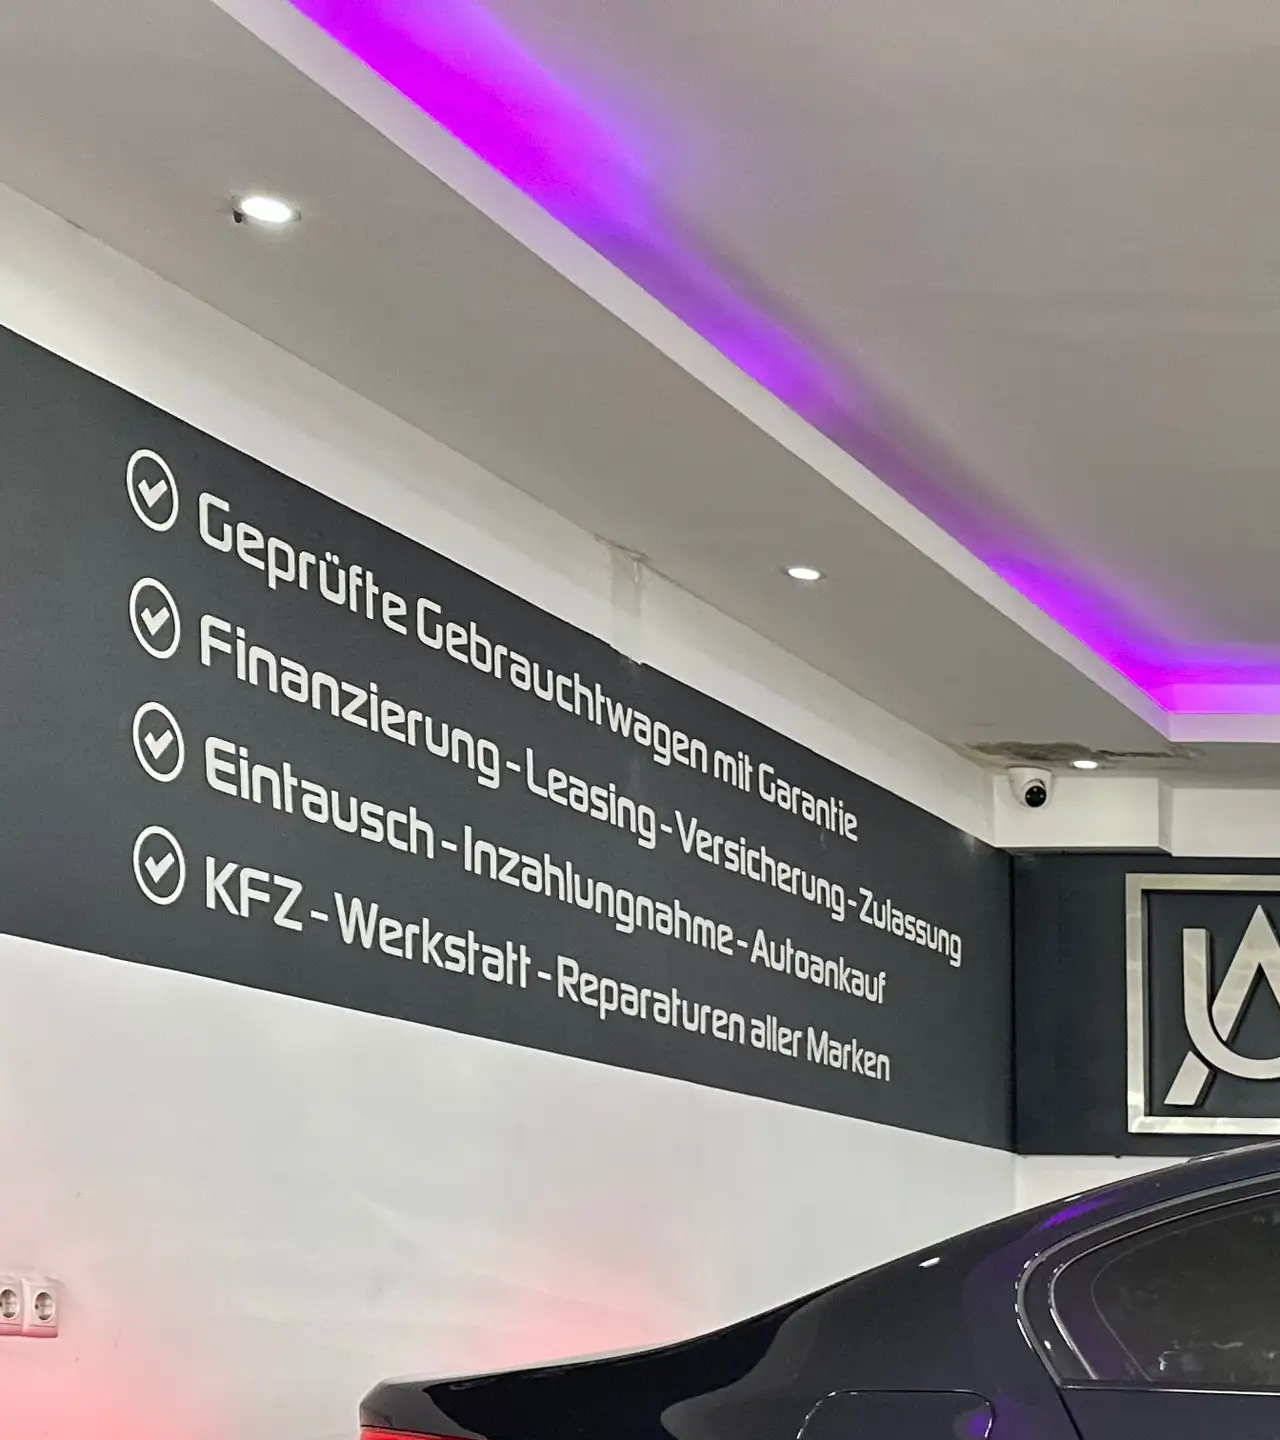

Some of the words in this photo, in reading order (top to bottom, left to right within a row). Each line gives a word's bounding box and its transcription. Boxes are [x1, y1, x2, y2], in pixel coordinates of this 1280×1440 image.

[198, 492, 408, 636] Geprüfte
[416, 597, 708, 774] Gebrauchtwagen
[713, 748, 752, 793] mit
[758, 761, 859, 842] Garantie
[200, 614, 500, 790] Finanzierung
[526, 747, 656, 850] Leasing
[674, 810, 845, 922] Versicherung
[858, 886, 962, 968] Zulassung
[204, 736, 434, 859] Eintausch
[464, 825, 733, 956] Inzahlungnahme
[750, 928, 886, 1004] Autoankauf
[205, 856, 303, 932] KFZ
[333, 891, 532, 989] Werkstatt
[556, 954, 745, 1044] Reparaturen
[750, 1014, 803, 1059] aller
[806, 1026, 890, 1082] Marken
